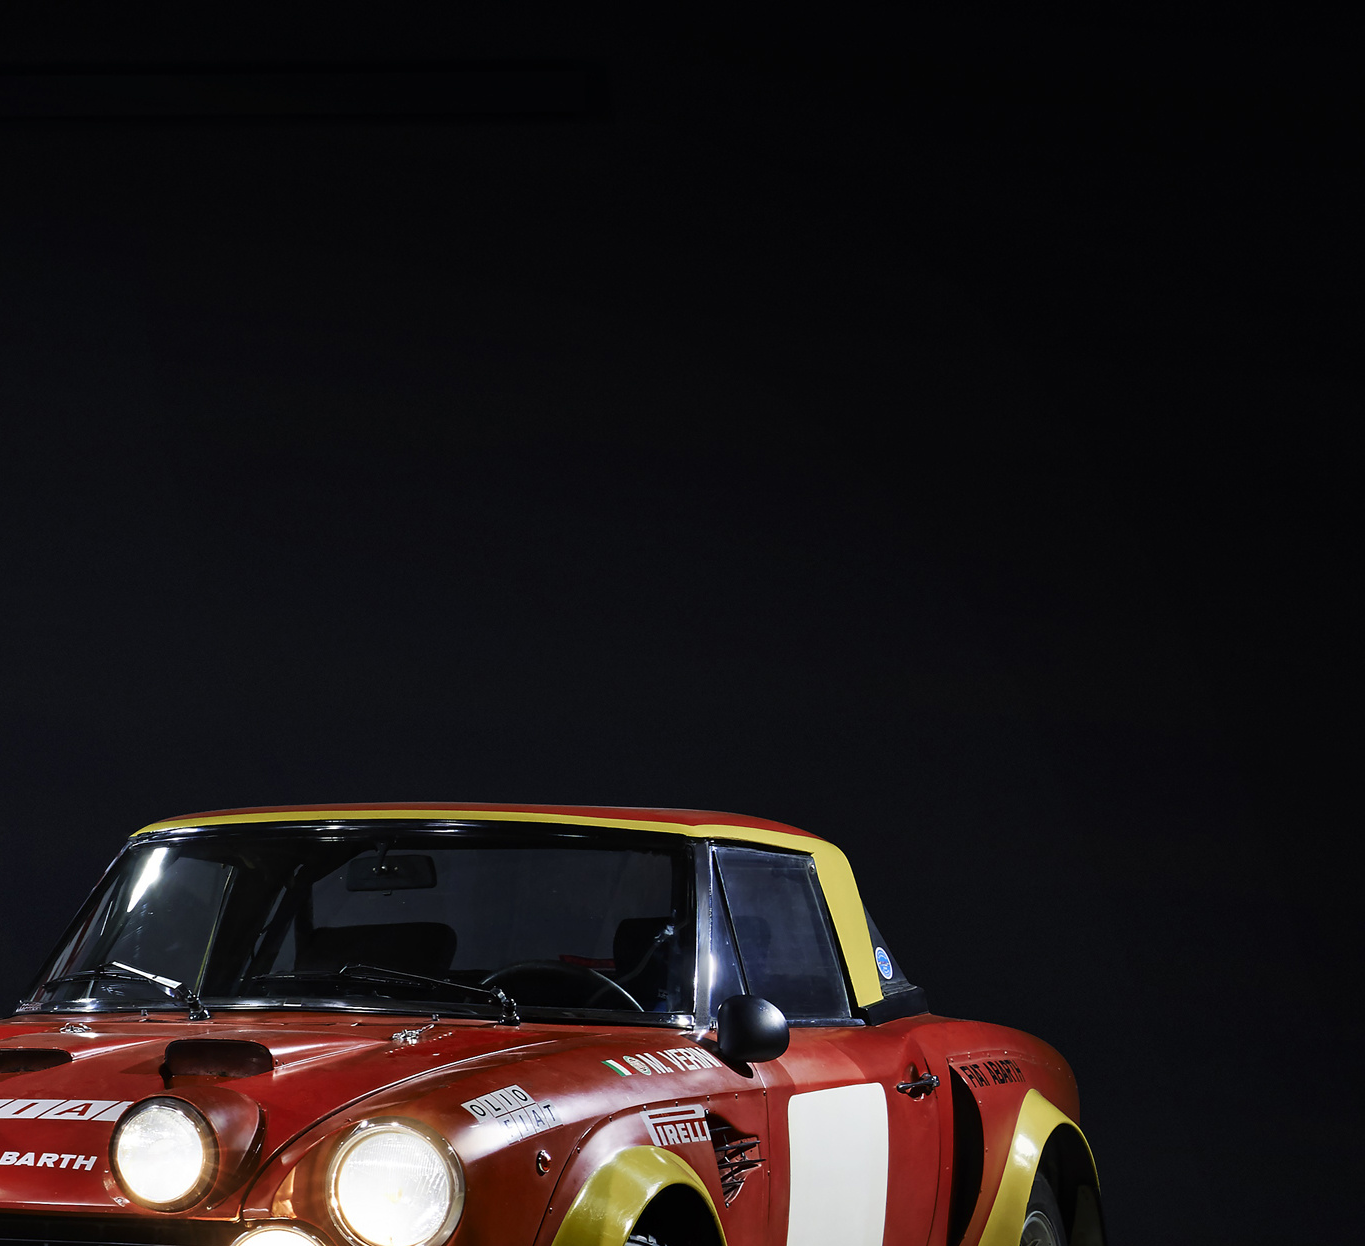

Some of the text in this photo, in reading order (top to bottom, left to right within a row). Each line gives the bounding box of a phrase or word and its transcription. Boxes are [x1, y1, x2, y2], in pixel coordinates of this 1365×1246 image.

[959, 1059, 1026, 1088] FIAT ABARTH
[469, 1088, 529, 1117] OLIO
[639, 1104, 711, 1147] PIRELLI
